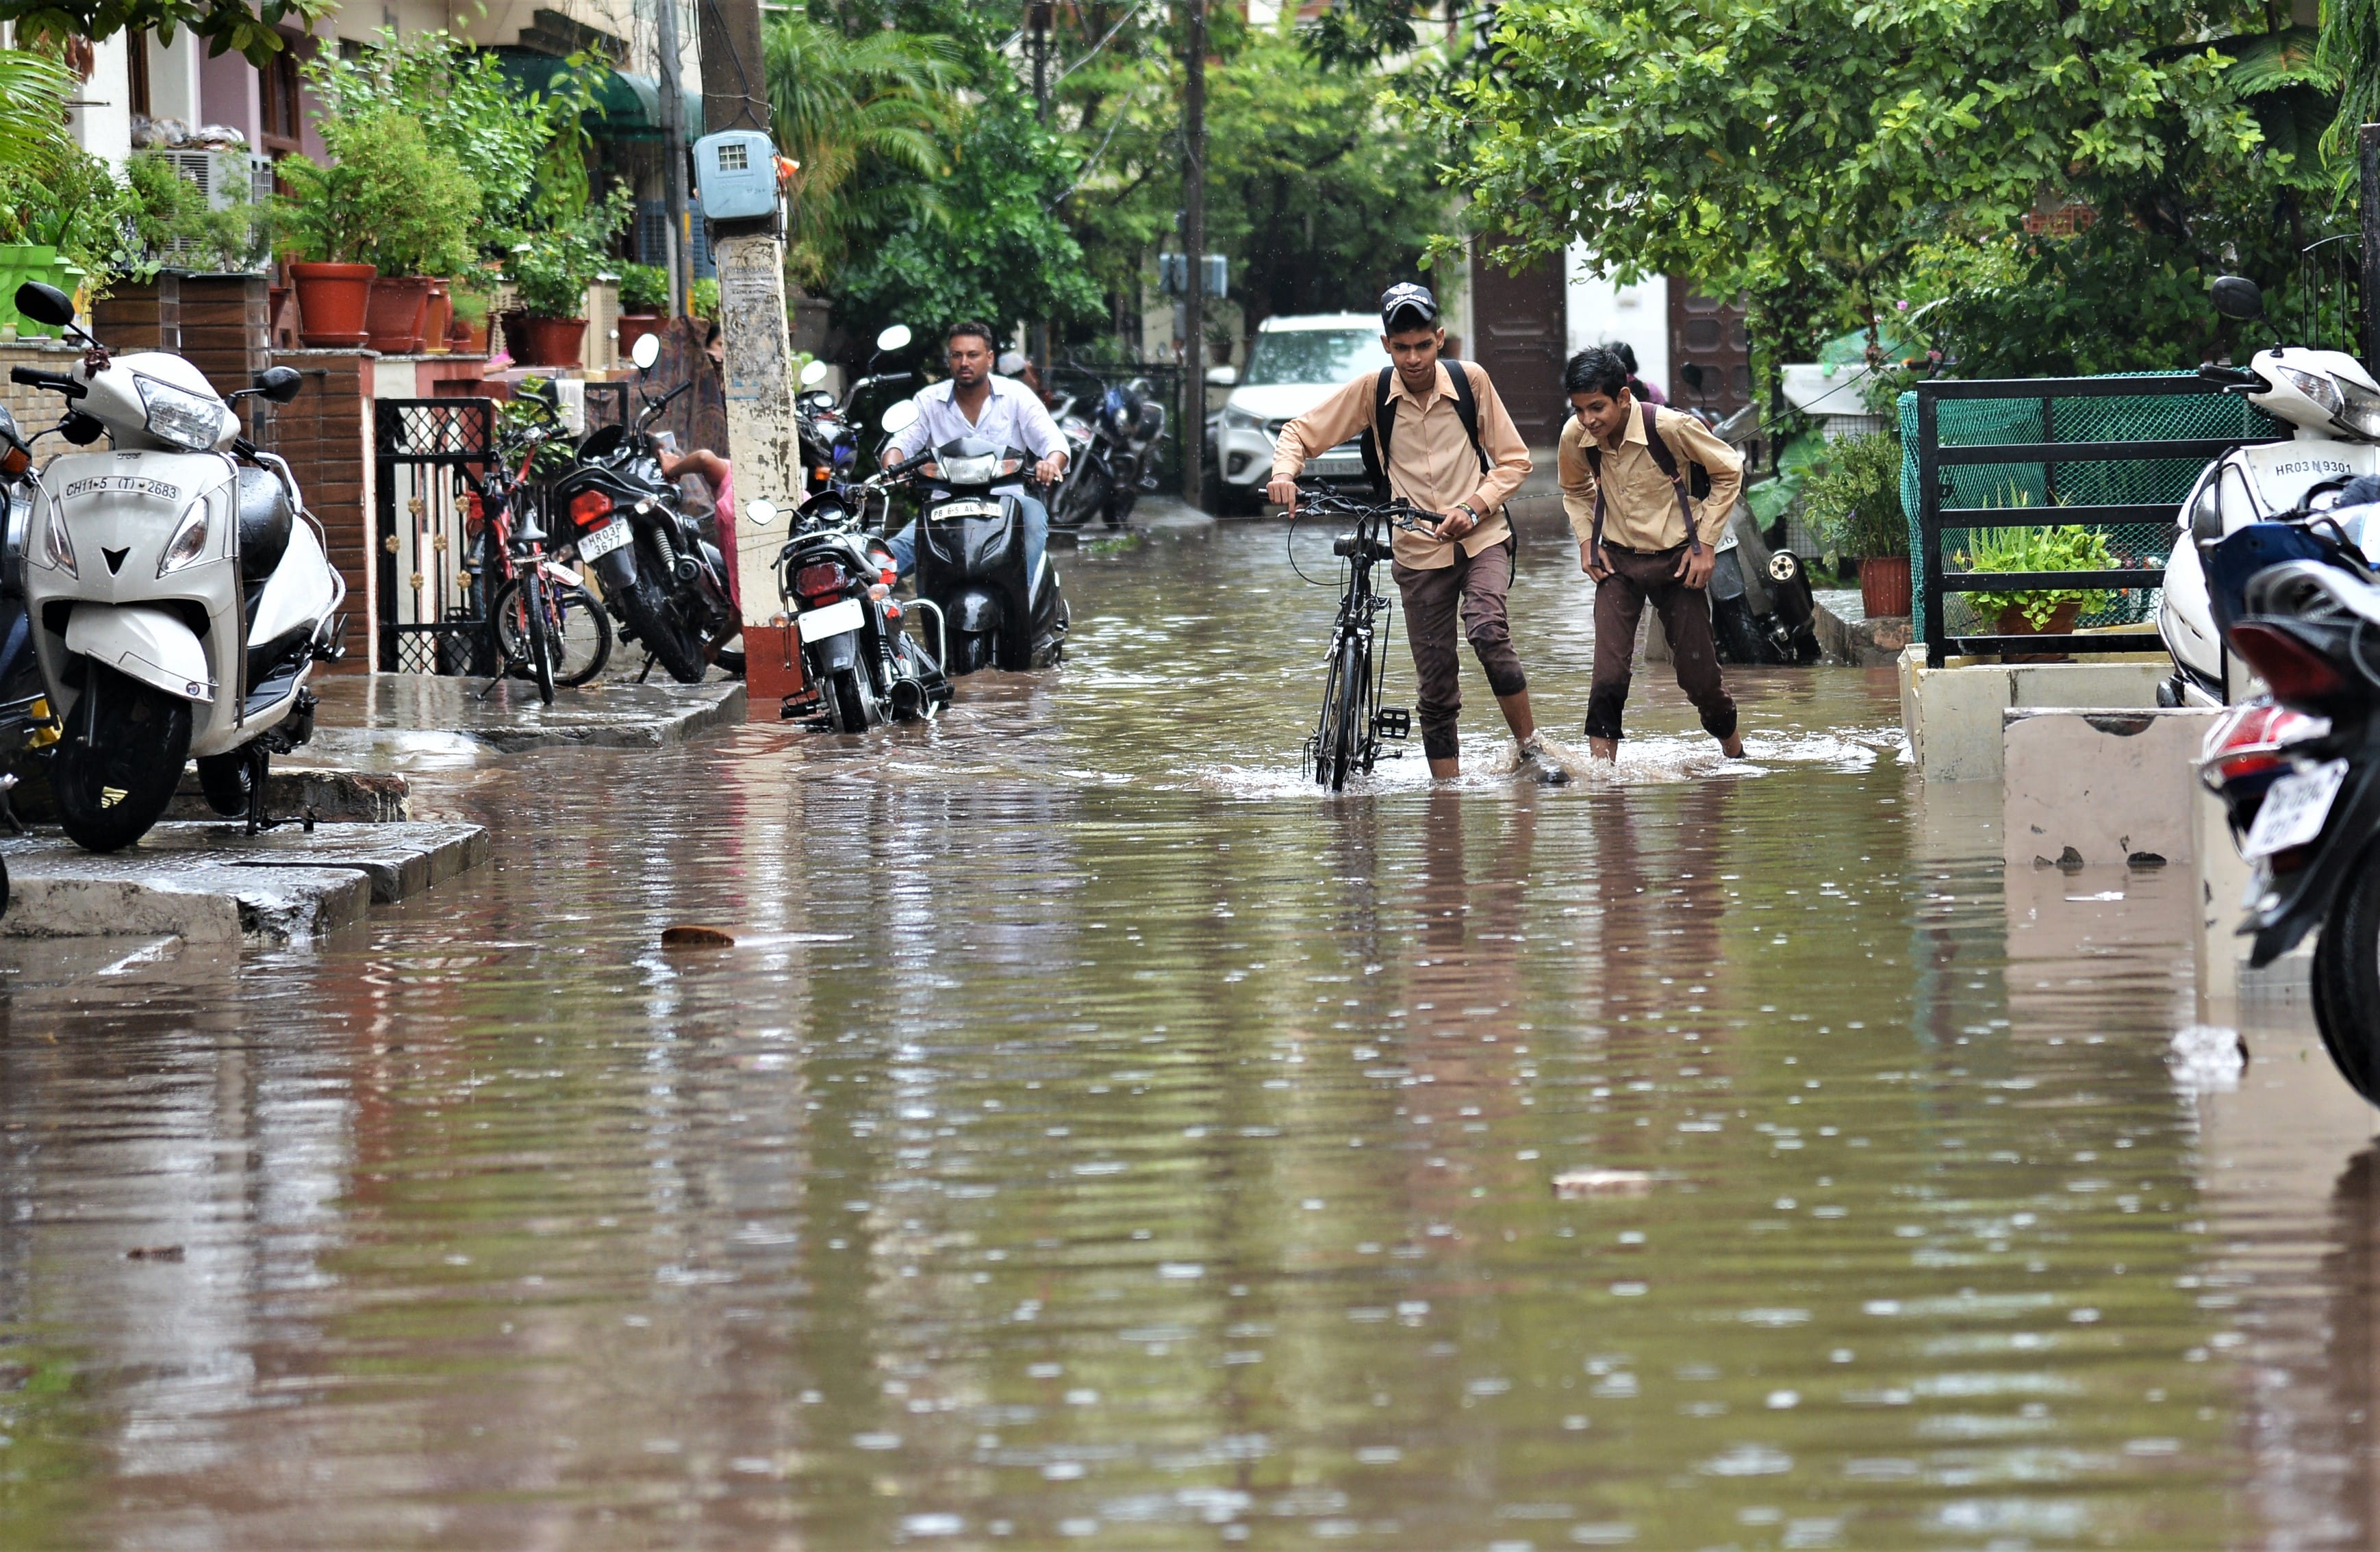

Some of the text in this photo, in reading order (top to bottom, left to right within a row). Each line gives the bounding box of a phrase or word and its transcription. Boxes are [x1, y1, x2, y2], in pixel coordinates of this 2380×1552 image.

[1386, 294, 1428, 311] adidas
[118, 478, 135, 489] (T)
[148, 482, 176, 499] 2683
[934, 510, 943, 518] PB
[594, 535, 620, 555] 3677
